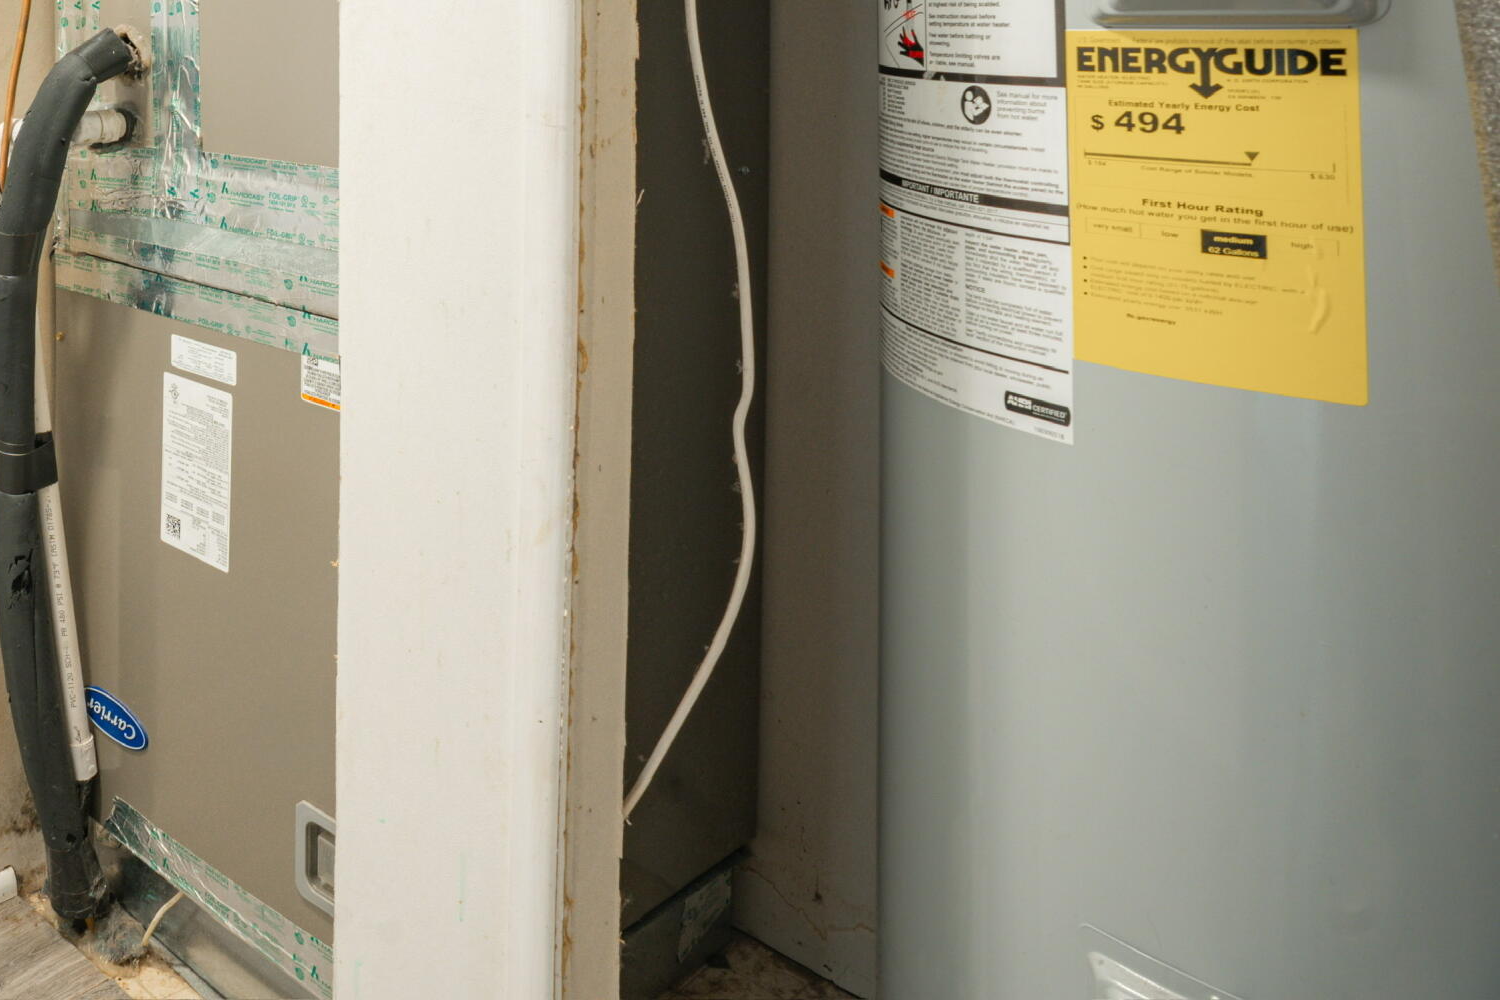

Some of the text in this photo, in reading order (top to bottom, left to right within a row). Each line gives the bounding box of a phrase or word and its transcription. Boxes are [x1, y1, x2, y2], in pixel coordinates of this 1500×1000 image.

[1076, 46, 1348, 83] ENERGYGUIDE
[1108, 99, 1260, 113] Estimated Yearly Energy Cost
[1091, 111, 1186, 135] $ 494
[902, 179, 929, 194] IMPORTANT
[934, 187, 979, 203] IMPORTANTE
[1141, 198, 1264, 217] First Hour Rating
[1100, 206, 1126, 214] much
[1129, 208, 1145, 216] hot
[1148, 211, 1174, 219] water
[1178, 213, 1197, 221] you
[1200, 215, 1217, 223] get
[1234, 217, 1251, 225] the
[1255, 218, 1277, 228] first
[1280, 221, 1308, 230] hour
[1311, 222, 1324, 231] of
[1327, 224, 1354, 235] use)
[1092, 223, 1109, 233] very
[1111, 224, 1133, 234] small
[1213, 236, 1255, 246] medium
[1208, 246, 1260, 258] 62 Gallons
[88, 697, 136, 741] Carrier
